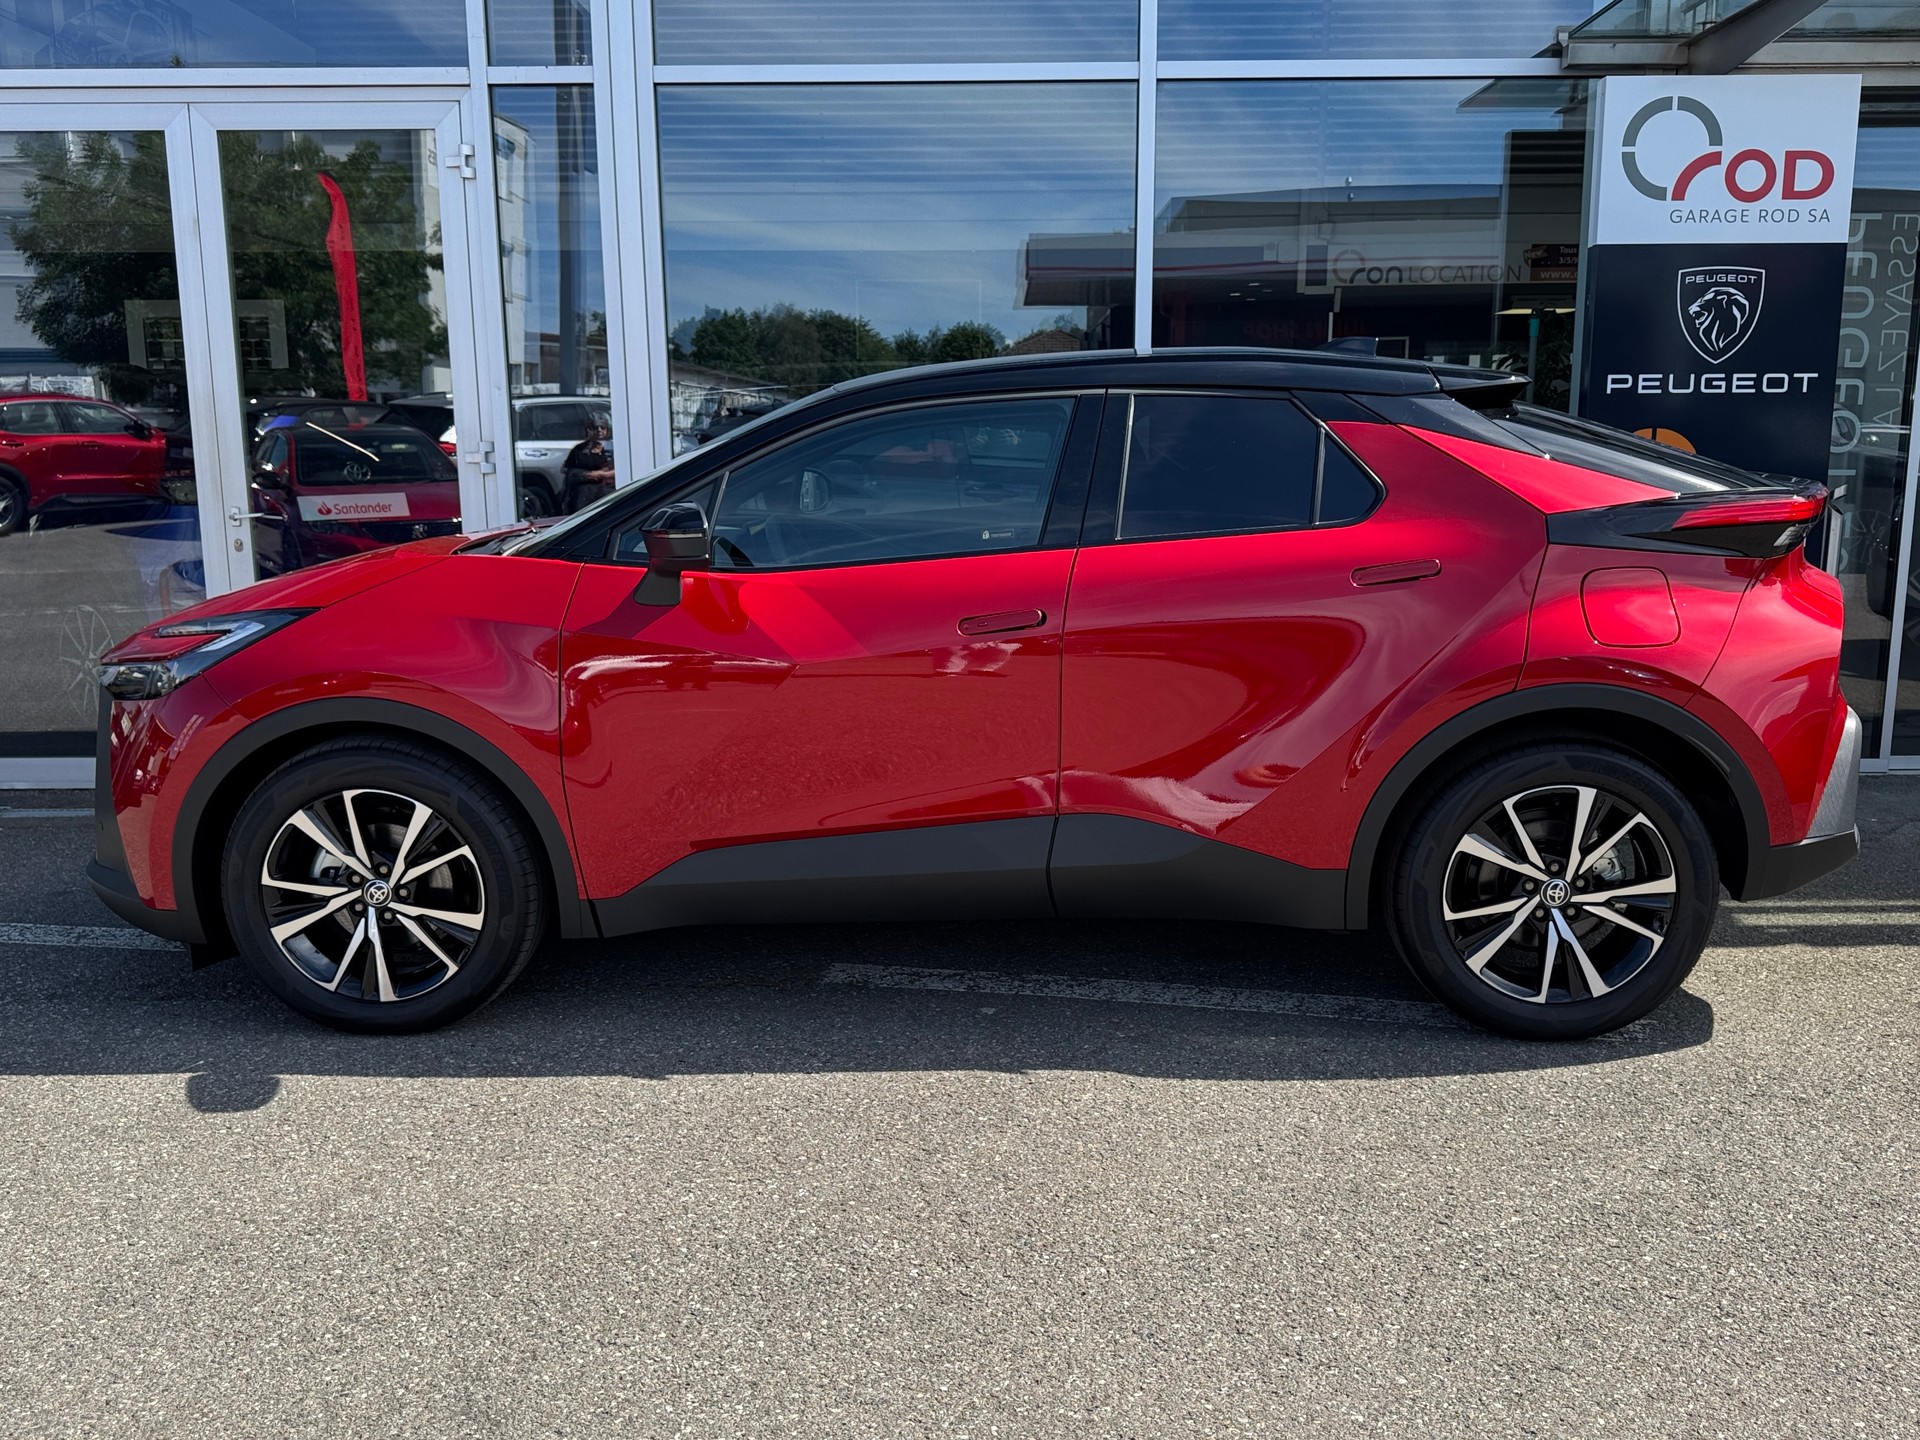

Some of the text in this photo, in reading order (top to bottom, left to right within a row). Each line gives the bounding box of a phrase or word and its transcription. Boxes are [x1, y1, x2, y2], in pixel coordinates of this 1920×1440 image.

[1669, 208, 1831, 224] GARAGE ROD SA
[1560, 246, 1577, 255] Tous
[1408, 264, 1521, 283] LOCATION
[1685, 274, 1758, 284] PEUGEOT
[1606, 372, 1819, 394] PEUGEOT
[333, 502, 392, 515] Santander
